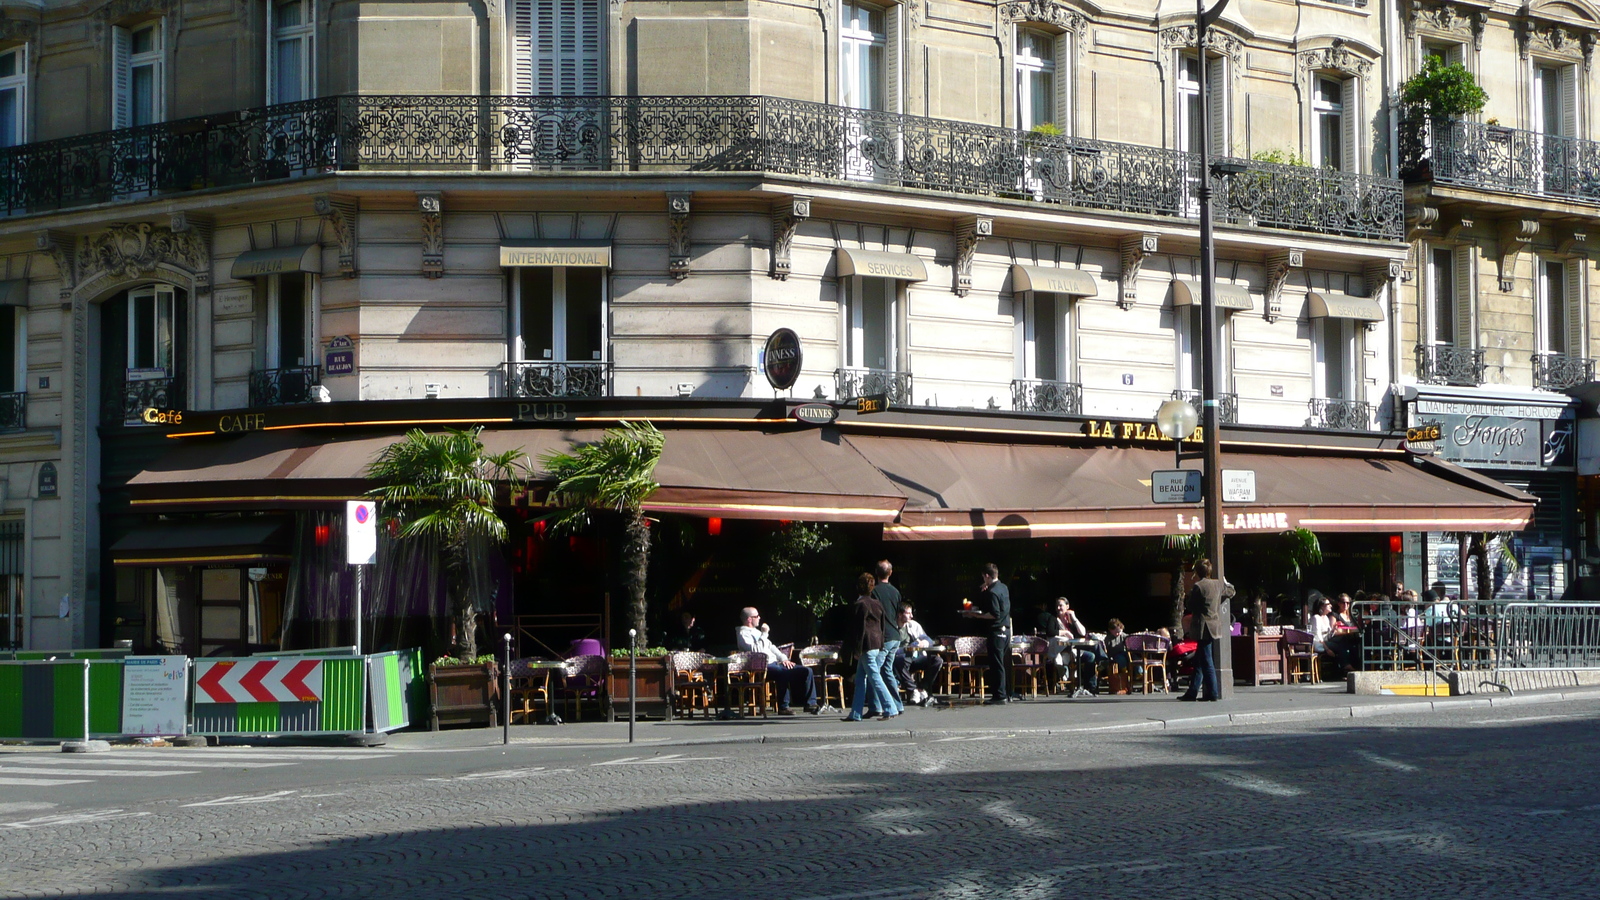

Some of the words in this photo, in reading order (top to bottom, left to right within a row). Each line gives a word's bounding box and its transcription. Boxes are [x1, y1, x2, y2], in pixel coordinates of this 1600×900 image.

[508, 252, 601, 265] INTERNATIONAL
[251, 260, 282, 273] ITALIA
[867, 262, 913, 277] SERVICES
[1047, 279, 1080, 292] ITALIA
[1192, 291, 1252, 308] INNATIONAL
[1337, 305, 1373, 318] SERVICES
[328, 363, 352, 371] BEAUJON
[517, 402, 568, 421] PUB
[857, 397, 880, 412] Bar
[1460, 404, 1504, 416] JOAILLIER
[1518, 406, 1568, 419] HORLOGER
[143, 407, 183, 424] Café
[219, 413, 266, 433] CAFE
[1089, 420, 1115, 438] LA
[1122, 422, 1204, 443] FLAE
[1406, 426, 1438, 441] Café
[1453, 415, 1527, 457] Forges
[1159, 485, 1195, 493] BEAUJON
[1177, 513, 1202, 530] LA
[1221, 512, 1289, 529] LAMME
